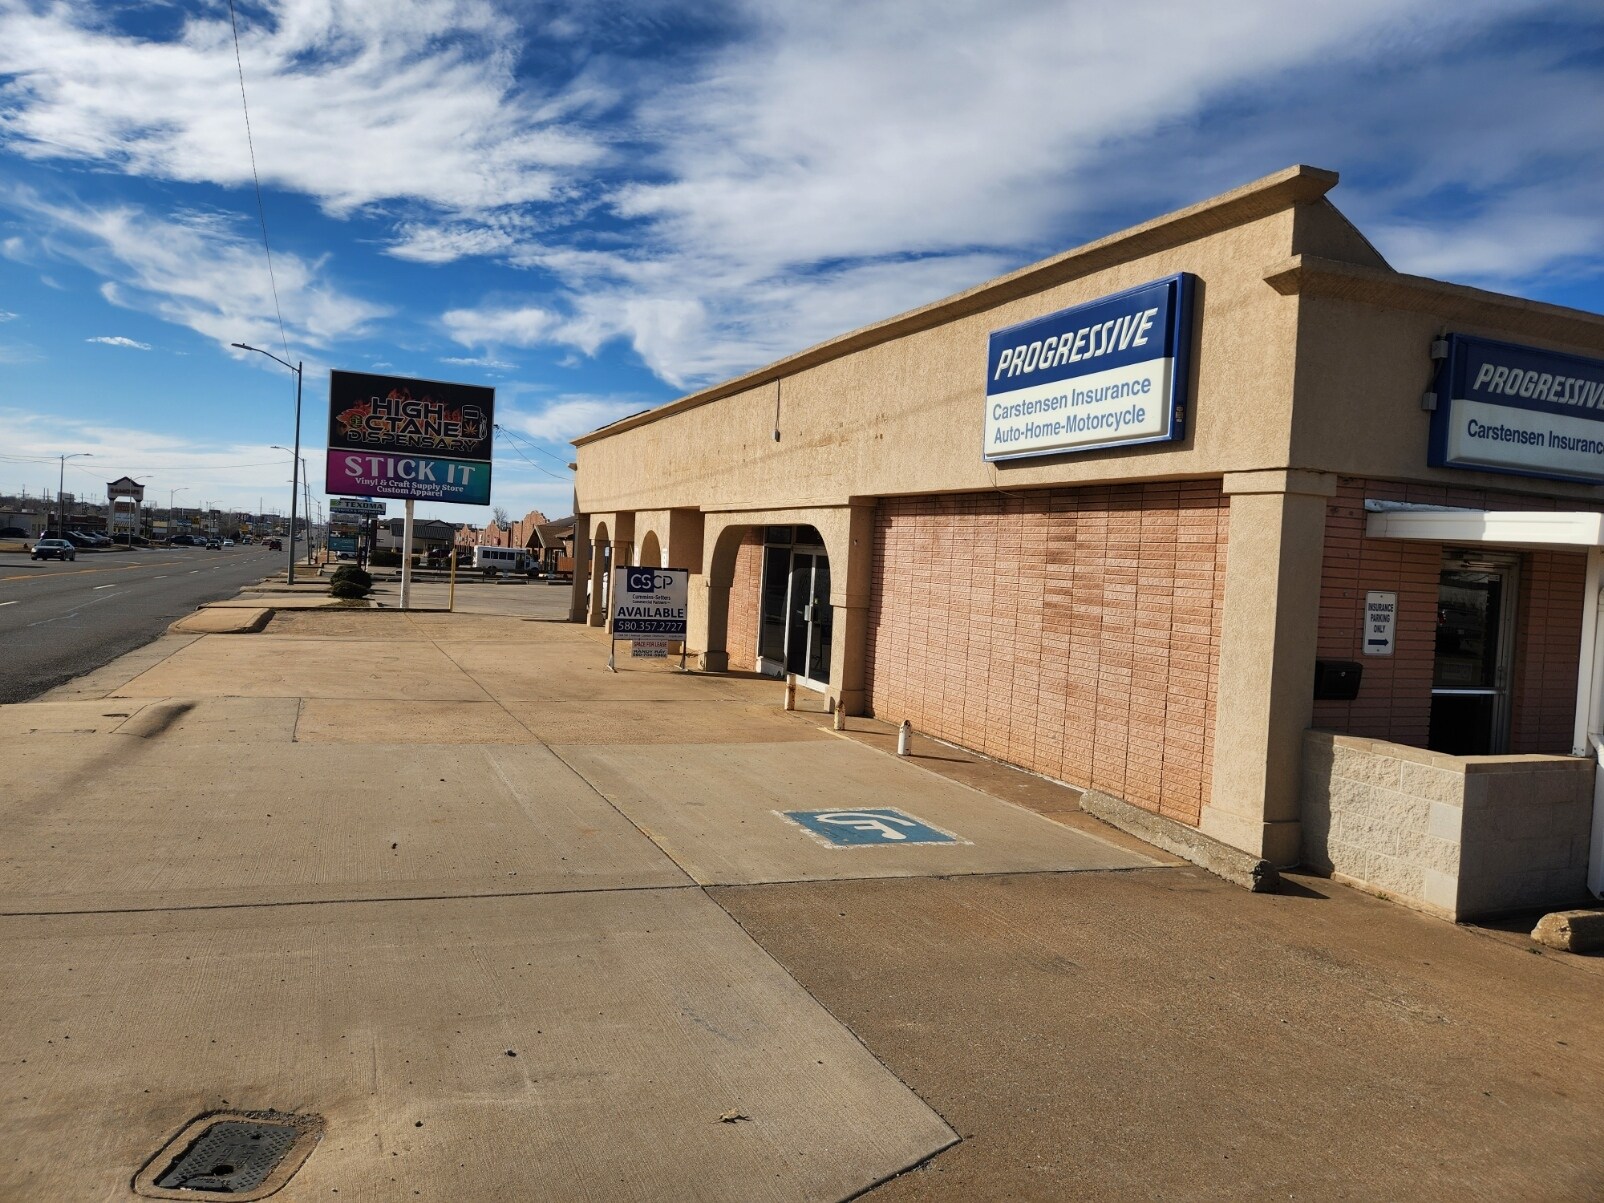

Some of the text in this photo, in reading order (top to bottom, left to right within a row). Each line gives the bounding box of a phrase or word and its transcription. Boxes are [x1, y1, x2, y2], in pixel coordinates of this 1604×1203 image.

[994, 307, 1158, 380] PROGRESSIVE
[992, 377, 1152, 421] Carstensen Insurance
[372, 396, 444, 420] HIGH
[994, 404, 1146, 444] Auto-Home-Motorcycle
[346, 430, 478, 451] DISPENSARY
[1468, 419, 1604, 456] Carstensen Insuranc
[344, 456, 476, 486] STICK IT
[355, 477, 378, 486] Vinyl
[388, 480, 410, 488] Craft
[412, 482, 440, 492] Supply
[442, 484, 464, 492] Store
[376, 486, 443, 497] Custom Apparel
[630, 574, 673, 590] CSCP
[618, 606, 684, 618] AVAILABLE
[1368, 602, 1394, 612] INSURANCE
[618, 621, 682, 631] 580.357.2727
[1370, 614, 1390, 623] PARKING
[1374, 624, 1386, 633] ONLY
